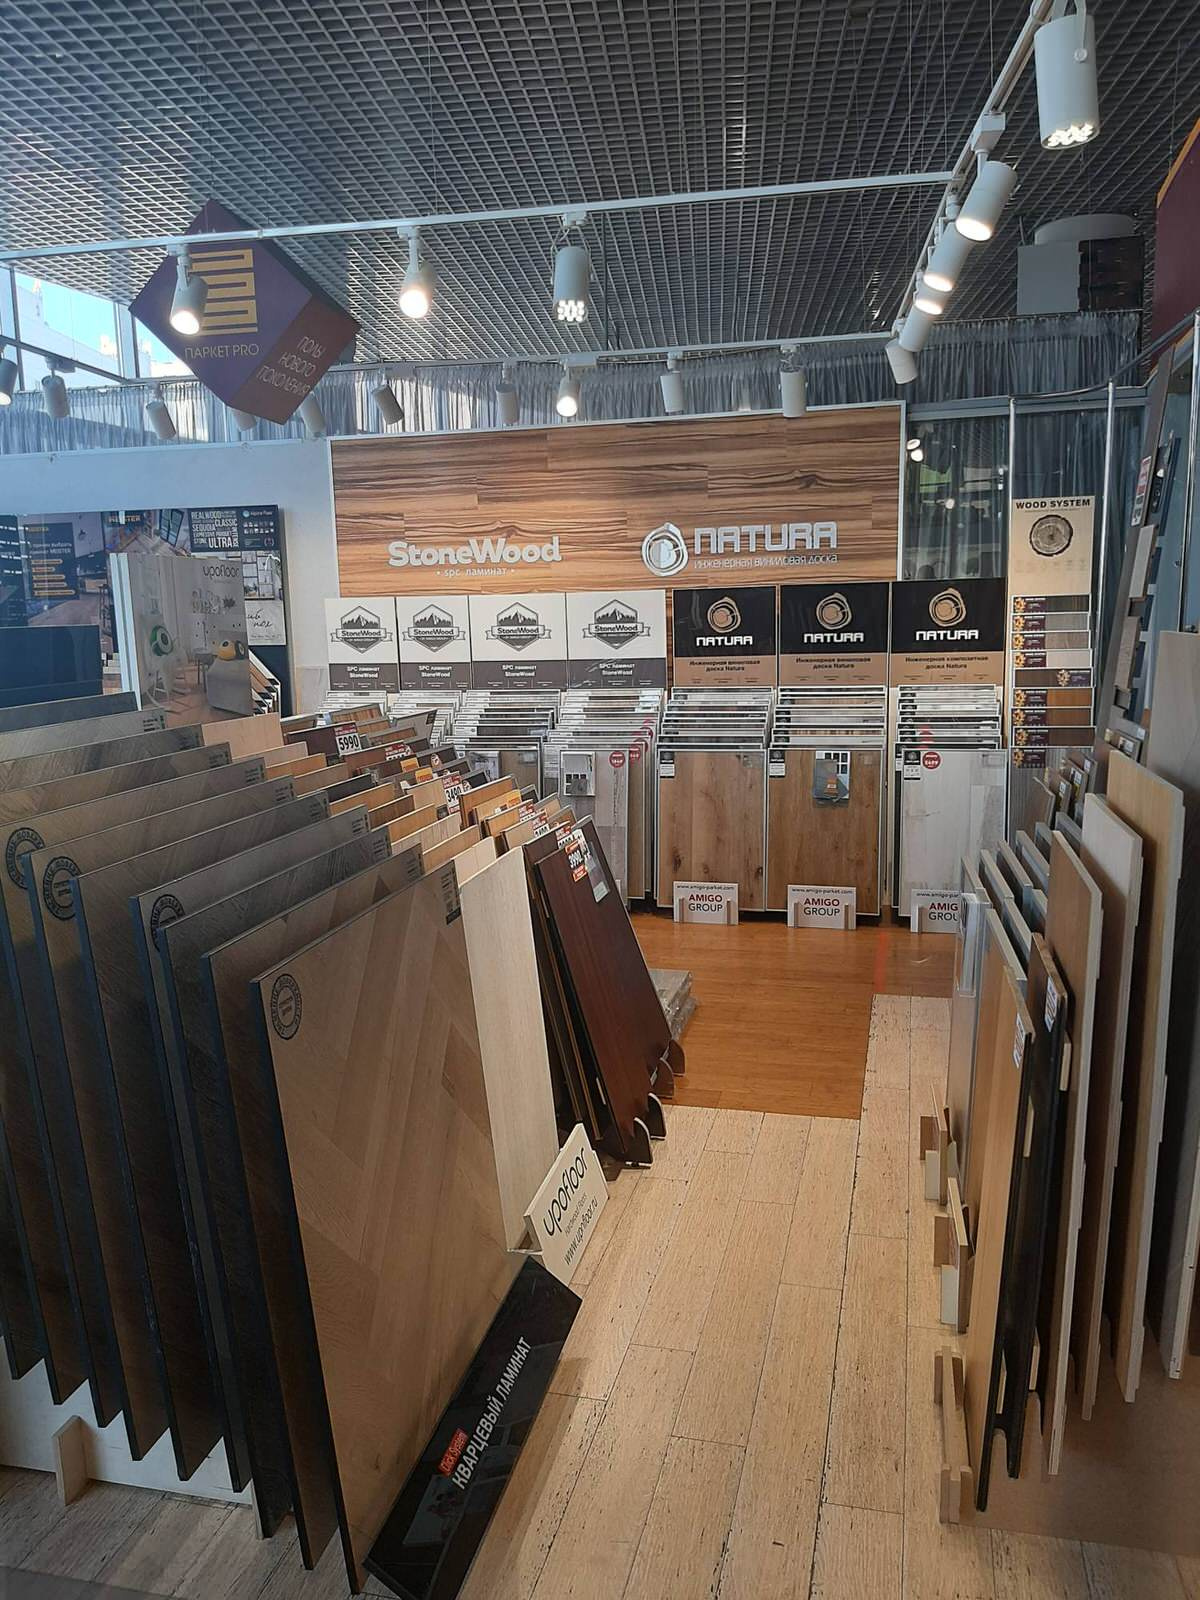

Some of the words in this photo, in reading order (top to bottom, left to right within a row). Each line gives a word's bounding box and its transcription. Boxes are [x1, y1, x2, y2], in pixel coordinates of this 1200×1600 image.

[184, 345, 230, 360] ПАРКЕТ
[232, 344, 260, 356] PRO
[1016, 501, 1047, 509] WOOD
[1050, 499, 1090, 508] SYSTEM
[215, 518, 237, 527] CLASSIC
[208, 536, 232, 548] ULTRA
[694, 521, 838, 554] NATURA
[388, 536, 562, 566] StoneWood
[444, 568, 461, 578] spc
[466, 568, 507, 576] ламинат
[696, 635, 752, 646] NATURA
[804, 632, 864, 643] NATURA
[916, 630, 979, 640] NATURA
[338, 735, 359, 750] 5990
[688, 903, 722, 912] GROUP
[804, 898, 840, 906] AMIGO
[803, 907, 840, 916] GROUP
[543, 1148, 587, 1236] upofloor
[452, 1395, 504, 1490] КВАРЦЕВЫЙ
[496, 1336, 531, 1400] ЛАМИНАТ
